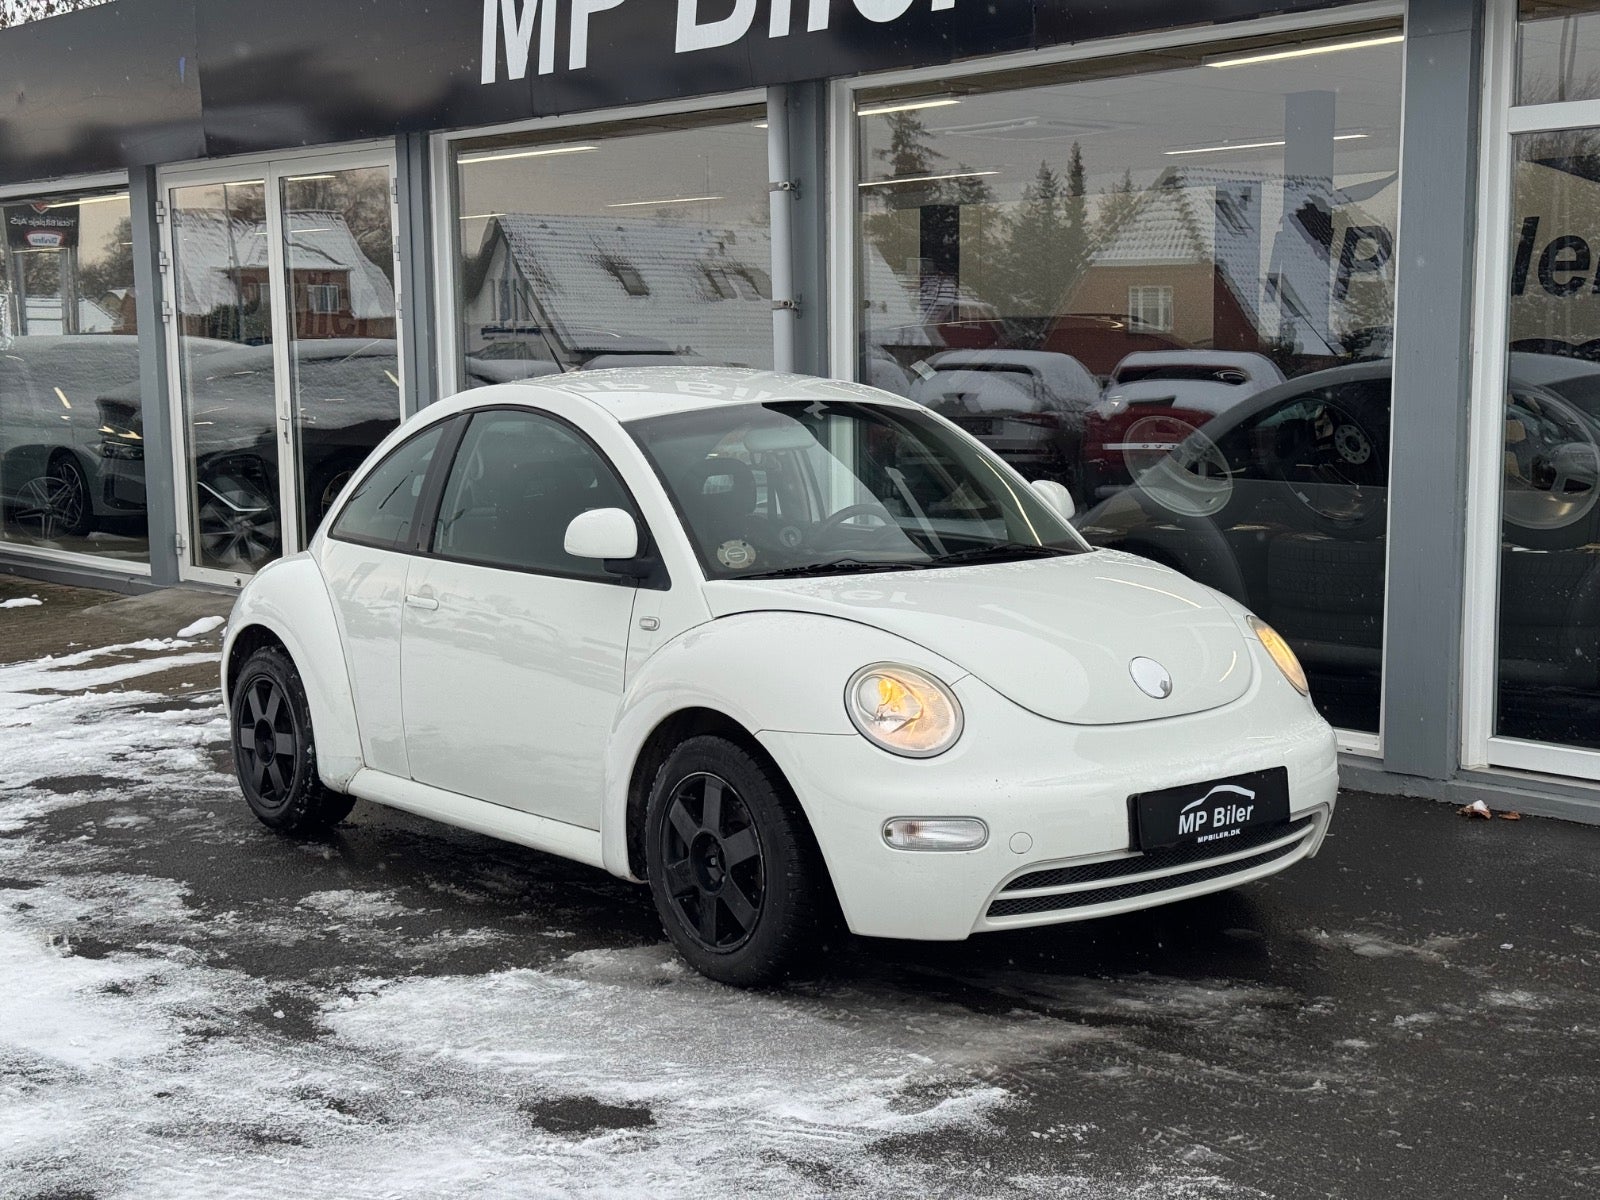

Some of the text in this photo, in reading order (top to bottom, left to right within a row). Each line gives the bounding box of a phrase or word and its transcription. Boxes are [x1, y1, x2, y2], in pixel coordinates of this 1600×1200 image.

[1178, 804, 1254, 835] MP Biler
[1197, 828, 1241, 843] MPBILER.DK
